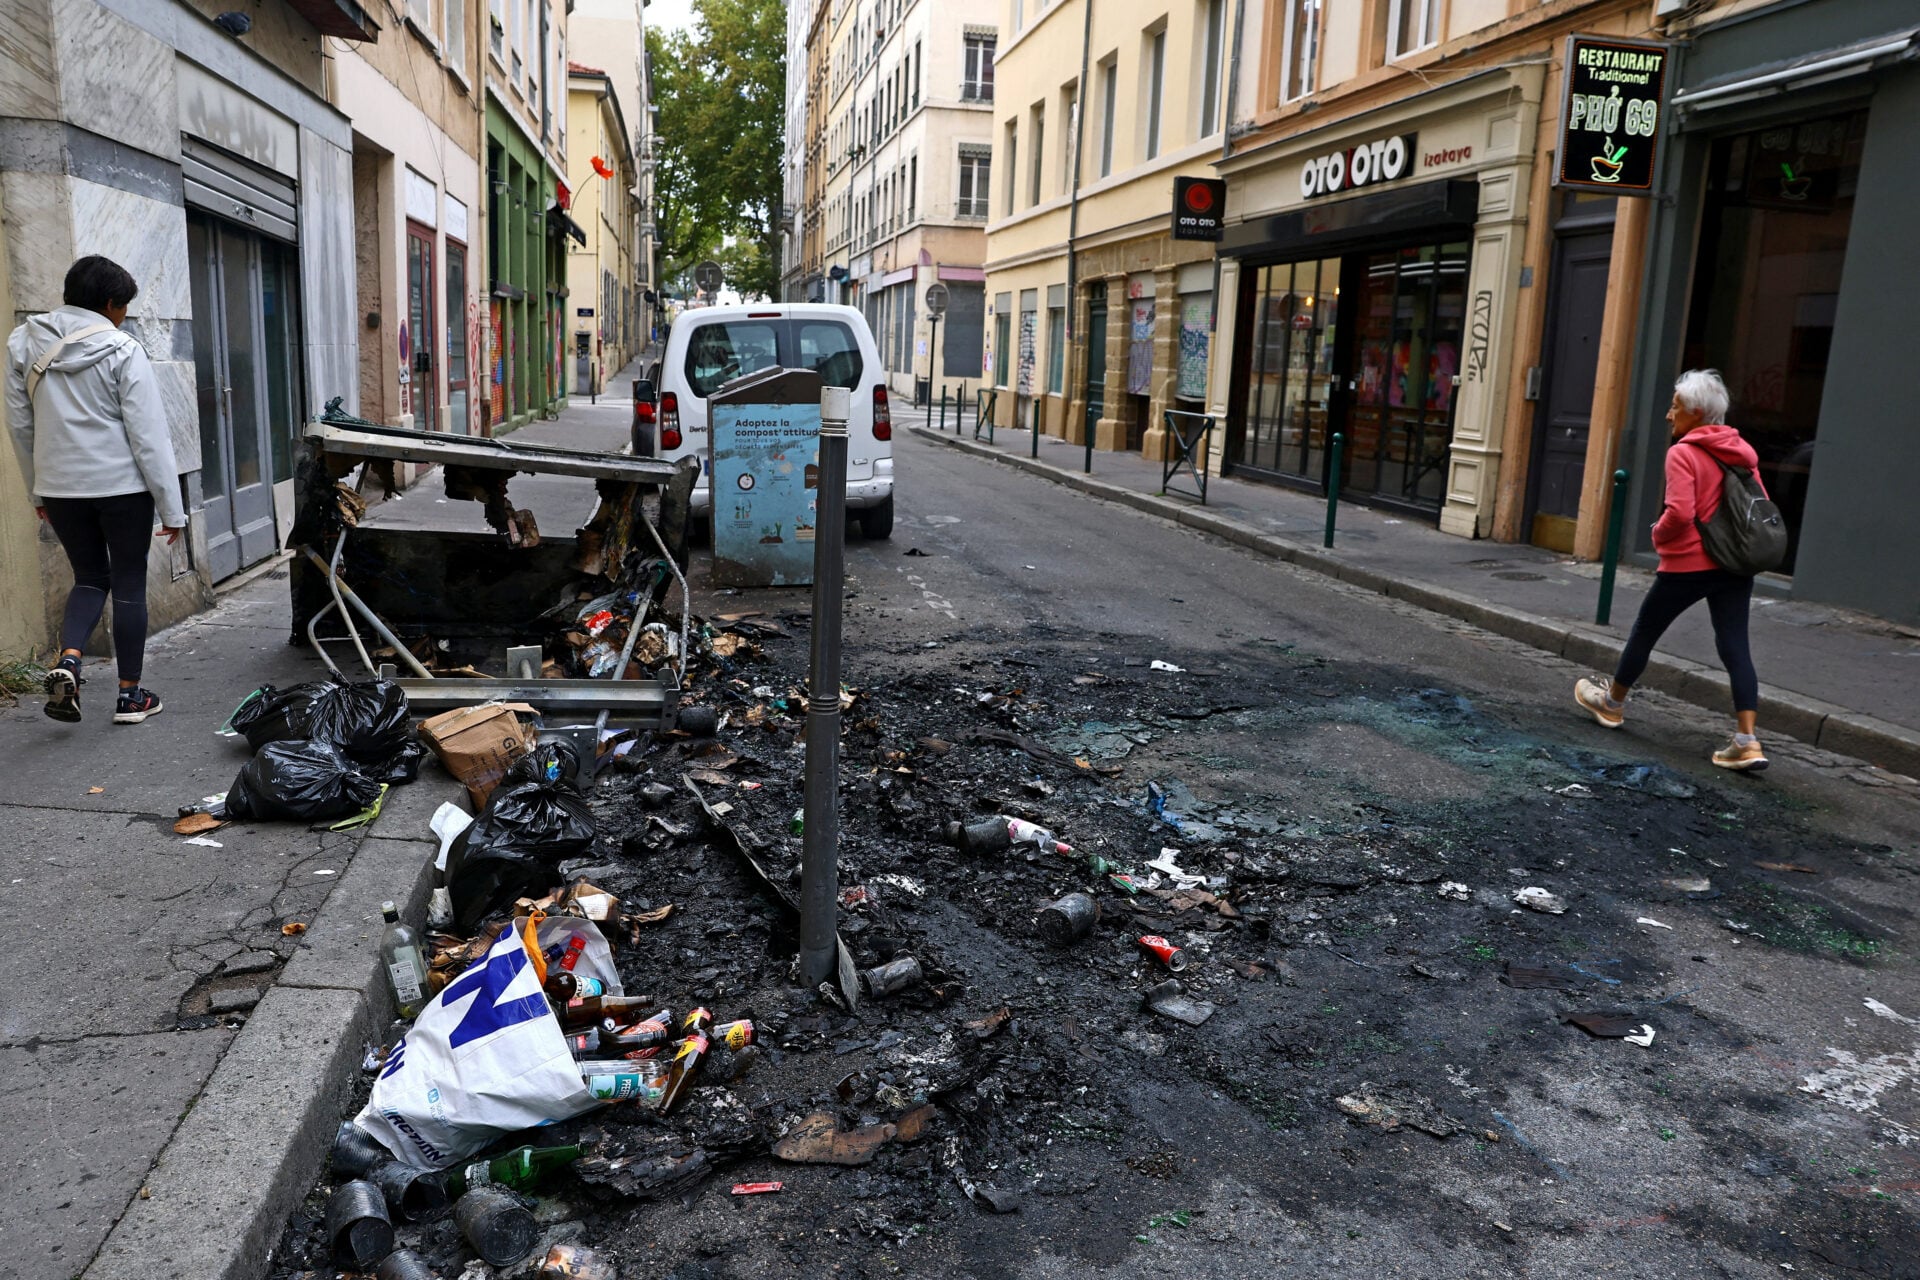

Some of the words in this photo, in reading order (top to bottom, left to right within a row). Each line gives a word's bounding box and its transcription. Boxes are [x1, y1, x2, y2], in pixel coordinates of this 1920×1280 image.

[1578, 48, 1662, 72] RESTAURANT
[1588, 67, 1650, 85] Traditionnel
[1625, 98, 1658, 137] 69
[1300, 152, 1345, 198] OTO
[1351, 136, 1405, 186] OTO
[1424, 145, 1473, 168] izakaya
[1180, 216, 1197, 226] OTO
[1199, 218, 1216, 227] OTO
[735, 419, 778, 429] Adoptez
[780, 418, 790, 427] la
[783, 428, 820, 436] attitud
[387, 1114, 446, 1162] ACTION
